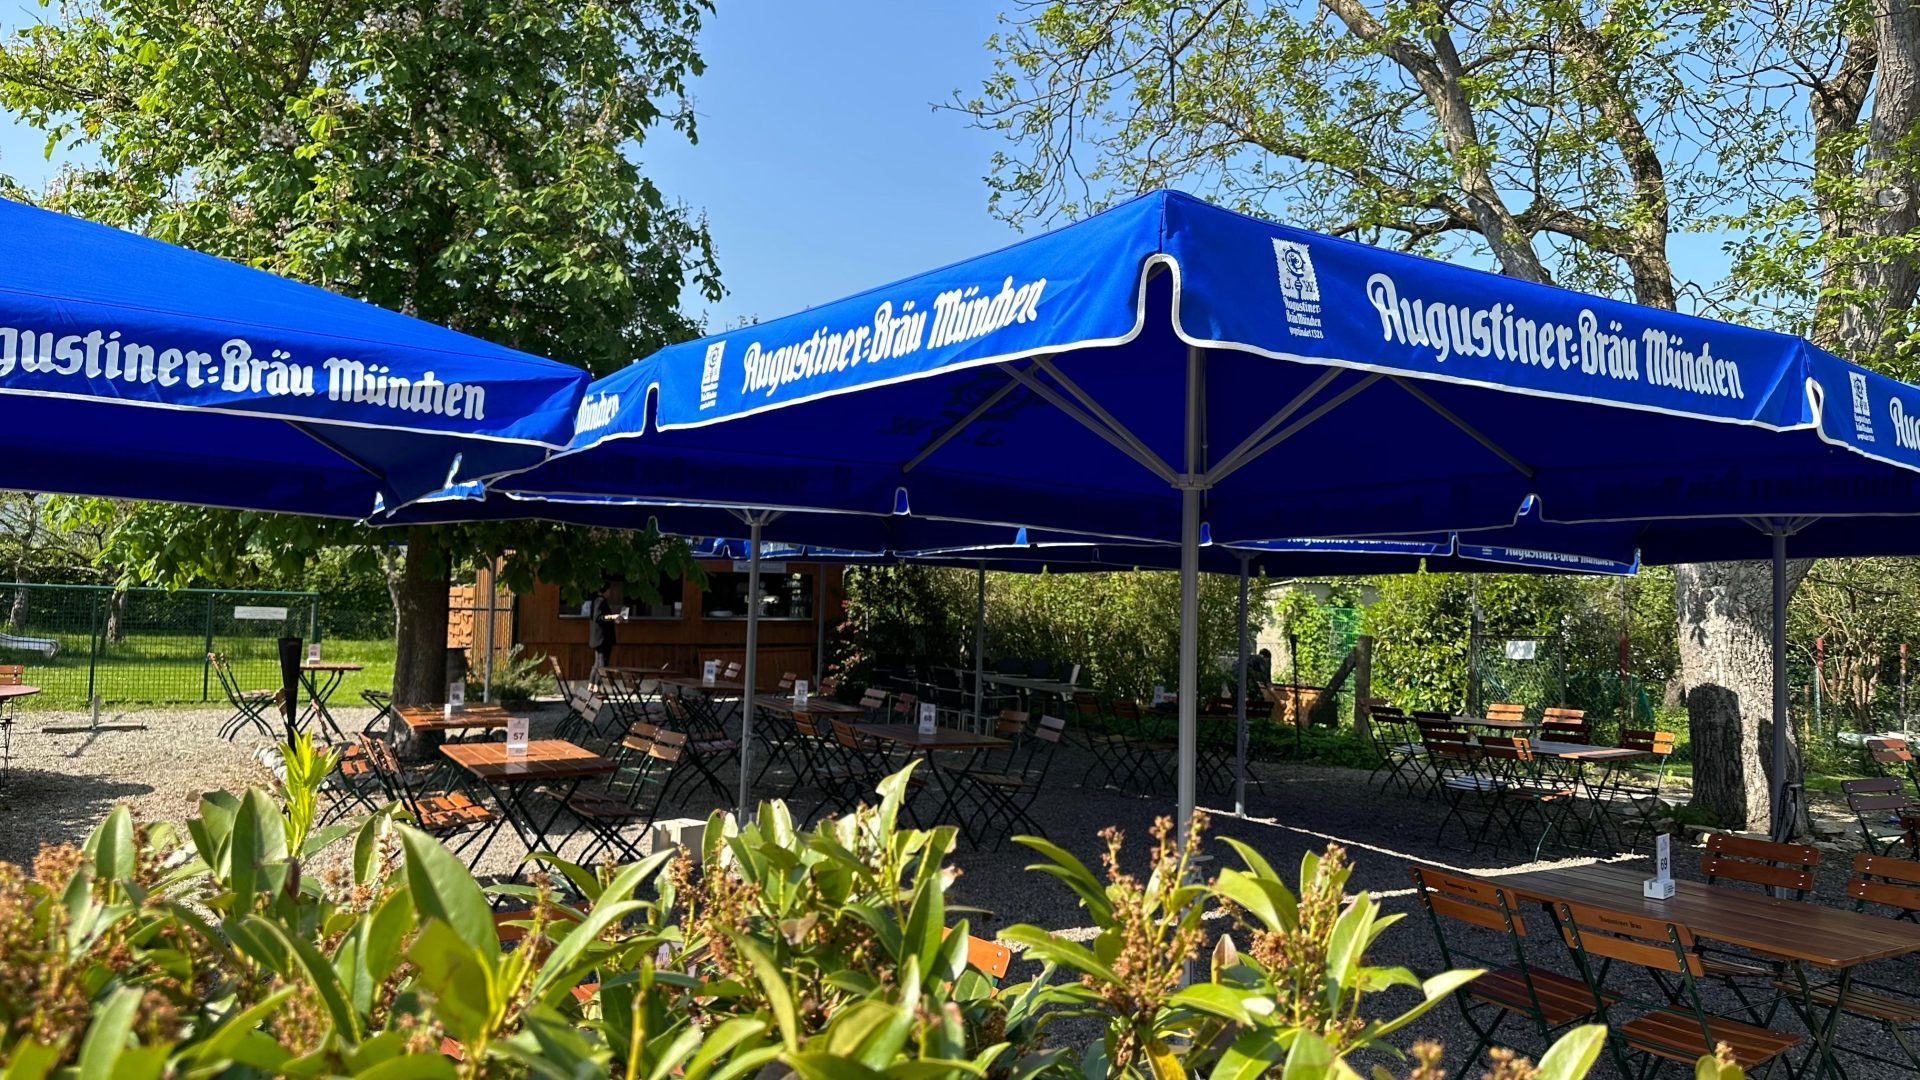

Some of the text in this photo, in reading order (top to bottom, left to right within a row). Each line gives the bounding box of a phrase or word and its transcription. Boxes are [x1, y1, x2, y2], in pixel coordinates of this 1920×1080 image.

[927, 275, 1047, 350] München
[323, 357, 485, 420] München
[1642, 328, 1744, 399] München
[1889, 397, 1920, 451] Au
[513, 732, 524, 740] 57
[1661, 857, 1667, 870] 69
